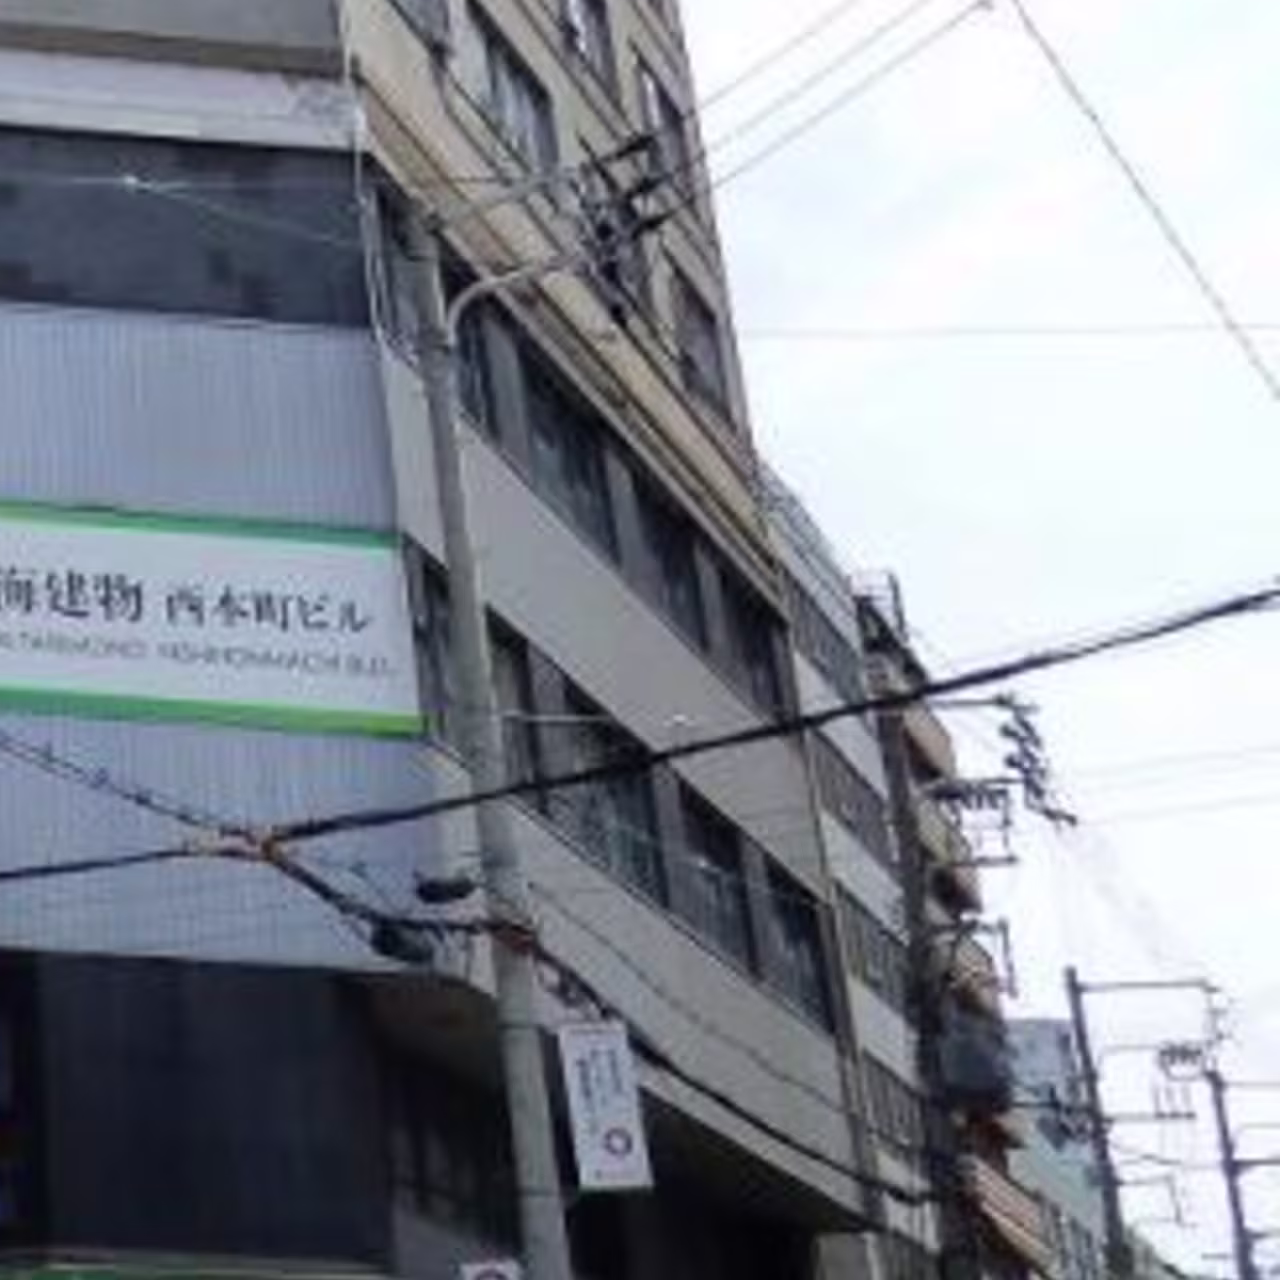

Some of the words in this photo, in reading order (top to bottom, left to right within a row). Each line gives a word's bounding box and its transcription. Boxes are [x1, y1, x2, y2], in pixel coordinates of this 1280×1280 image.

[165, 583, 371, 634] 西本町ビル
